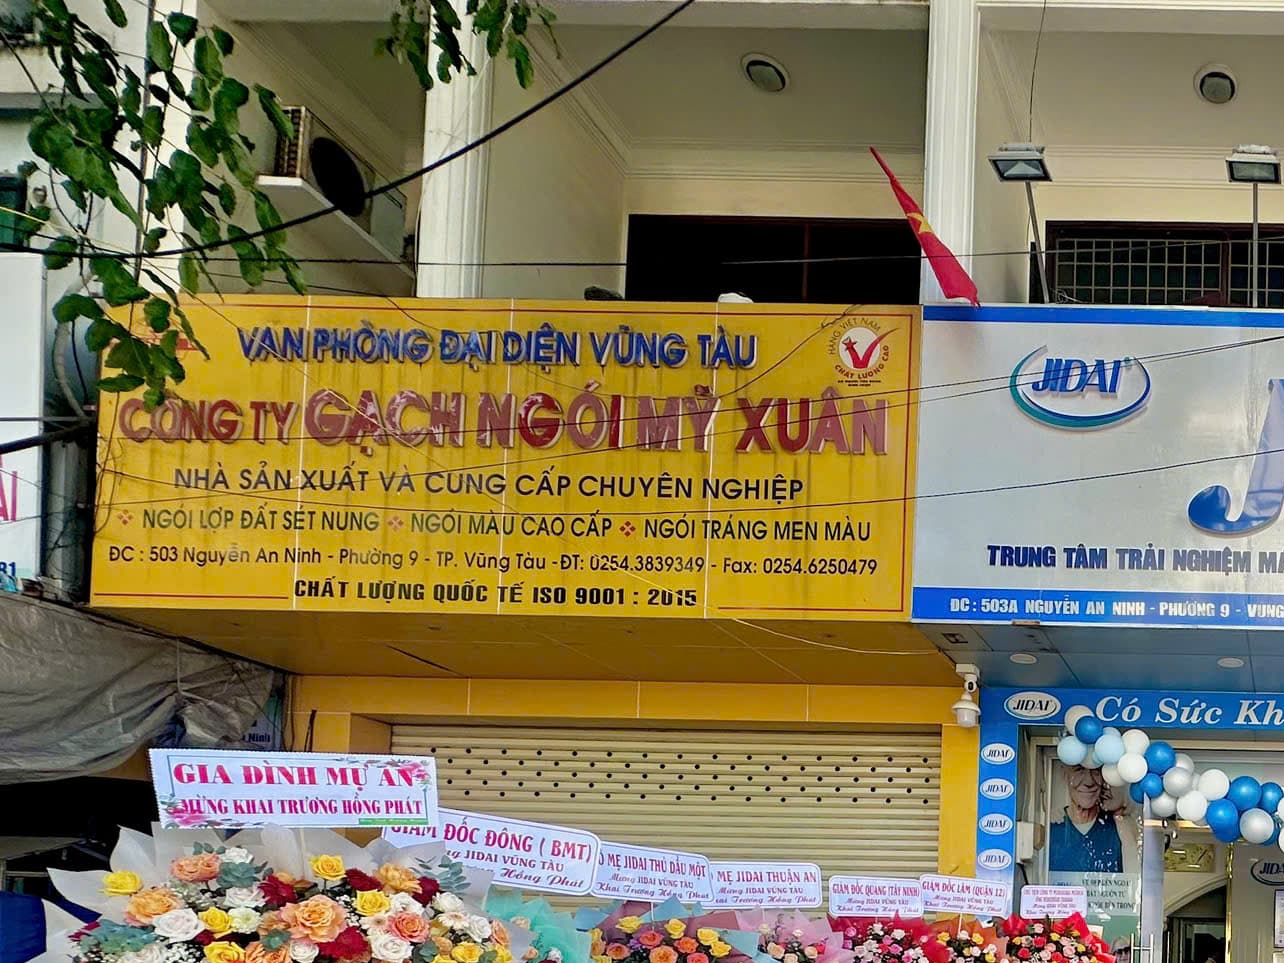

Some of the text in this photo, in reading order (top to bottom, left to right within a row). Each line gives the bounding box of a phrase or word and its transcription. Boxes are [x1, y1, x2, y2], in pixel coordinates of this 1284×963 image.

[314, 320, 432, 363] PHÒNG
[440, 329, 497, 371] ĐẠI
[503, 323, 582, 374] DIỆN
[589, 325, 690, 368] VŨNG
[697, 326, 758, 368] TÀU
[1032, 357, 1121, 395] JIDAI
[250, 399, 304, 445] TY
[305, 389, 465, 456] GẠCH
[477, 379, 625, 451] NGÓI
[736, 386, 889, 455] XUÂN
[175, 460, 803, 504] NHÀ SẢN XUẤT VÀ CUNG CẤP CHUYÊN NGHIỆP
[143, 505, 193, 530] NGÓI
[241, 502, 278, 530] ĐẤT
[282, 504, 316, 531] SÉT
[321, 509, 379, 531] NUNG
[411, 508, 612, 538] NGÓI MÀU CAO CẤP
[645, 514, 871, 542] NGÓI TRÁNG MEN MÀU
[150, 546, 177, 562] 503
[184, 543, 249, 566] Nguyễn
[256, 548, 278, 563] An
[284, 548, 321, 564] Ninh
[340, 548, 404, 569] Phường
[409, 551, 418, 566] 9
[437, 551, 457, 568] TP.
[465, 552, 510, 572] Vũng
[516, 553, 546, 569] Tàu
[590, 555, 704, 573] 0254.3839349
[723, 558, 757, 575] Fax:
[763, 558, 877, 576] 0254.6250479
[987, 544, 1056, 569] TRUNG
[1063, 543, 1108, 570] TÂM
[1116, 542, 1164, 571] TRẢI
[1172, 546, 1251, 577] NGHIỆM
[295, 576, 697, 606] CHẤT LƯỢNG QUỐC TẾ ISO 9001 2015
[981, 599, 1018, 614] 503A
[1025, 594, 1079, 615] NGUYỄN
[1086, 600, 1104, 616] AN
[1112, 601, 1145, 617] NINH
[1220, 604, 1230, 618] 9
[1013, 700, 1052, 711] JIDAI
[1096, 696, 1142, 723] Có
[1155, 698, 1223, 724] Sức
[986, 749, 1009, 758] JIDAI
[174, 763, 232, 784] GIA
[985, 785, 1008, 793] JIDAI
[233, 800, 273, 815] KHAI
[278, 797, 338, 815] TRƯƠNG
[343, 792, 380, 815] HỒNG
[386, 796, 422, 815] PHÁT
[444, 817, 480, 844] ĐỐC
[485, 827, 532, 853] ĐÔNG
[984, 820, 1007, 828] JIDAI
[502, 854, 536, 869] VŨNG
[624, 856, 646, 871] JIDAI
[983, 855, 1006, 863] JIDAI
[717, 871, 733, 885] MẸ
[736, 872, 762, 882] JIDAI
[804, 872, 816, 882] AN
